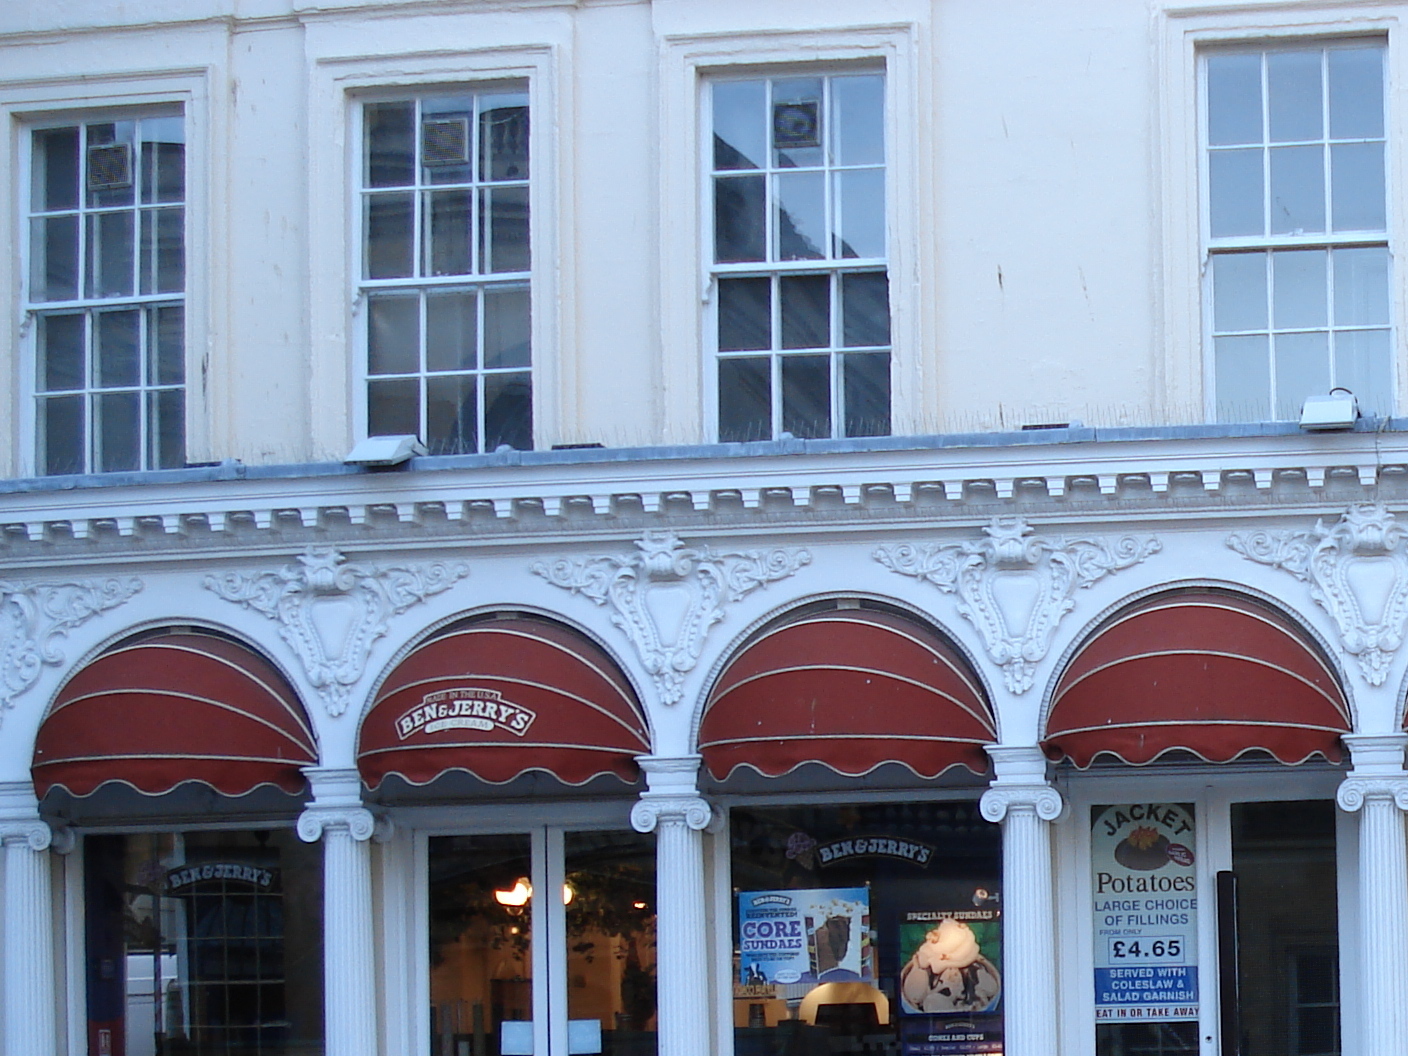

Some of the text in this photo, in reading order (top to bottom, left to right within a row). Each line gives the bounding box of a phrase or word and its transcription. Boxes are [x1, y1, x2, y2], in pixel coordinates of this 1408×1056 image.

[450, 719, 489, 728] CREAM
[1104, 804, 1192, 836] JACKET
[1096, 872, 1194, 894] Potatoes
[1095, 898, 1197, 911] LARGE CHOICE
[1105, 914, 1188, 926] OF FILLINGS
[743, 921, 802, 938] CORE
[744, 939, 802, 950] SUNDAES
[1113, 940, 1180, 958] £4.65
[1110, 968, 1186, 978] SERVED WITH
[1112, 980, 1184, 990] COLESLAW &
[1102, 991, 1194, 1002] SALAD GARNISH
[1096, 1008, 1199, 1018] EAT IN OR TAKE AWAY
